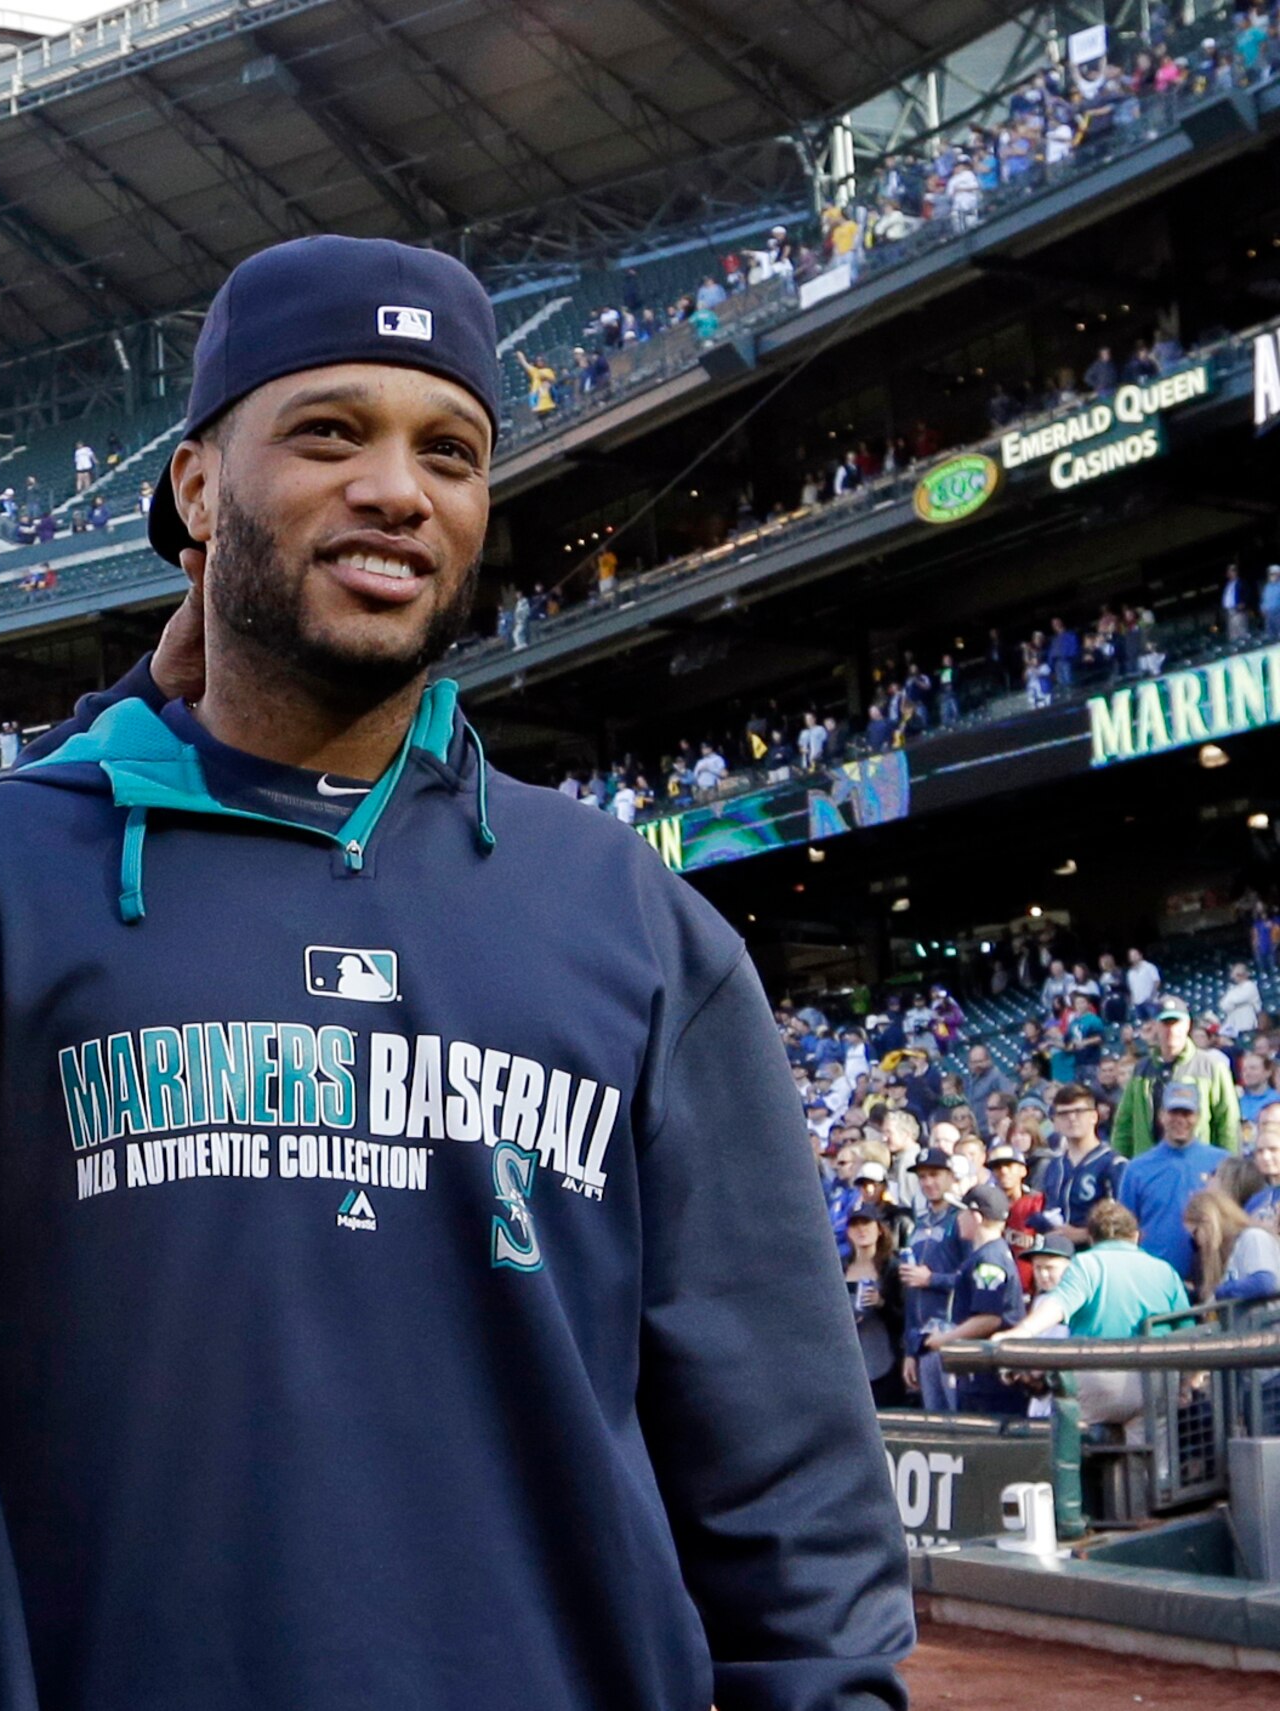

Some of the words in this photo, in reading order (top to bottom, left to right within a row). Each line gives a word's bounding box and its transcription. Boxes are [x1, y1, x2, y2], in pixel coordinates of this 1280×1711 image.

[58, 1021, 357, 1151] MARINERS
[370, 1031, 621, 1188] BASEBALL
[76, 1147, 117, 1200] MLB
[125, 1134, 270, 1190] AUTHENTIC
[278, 1134, 428, 1191] COLLECTION
[1078, 1173, 1097, 1202] S
